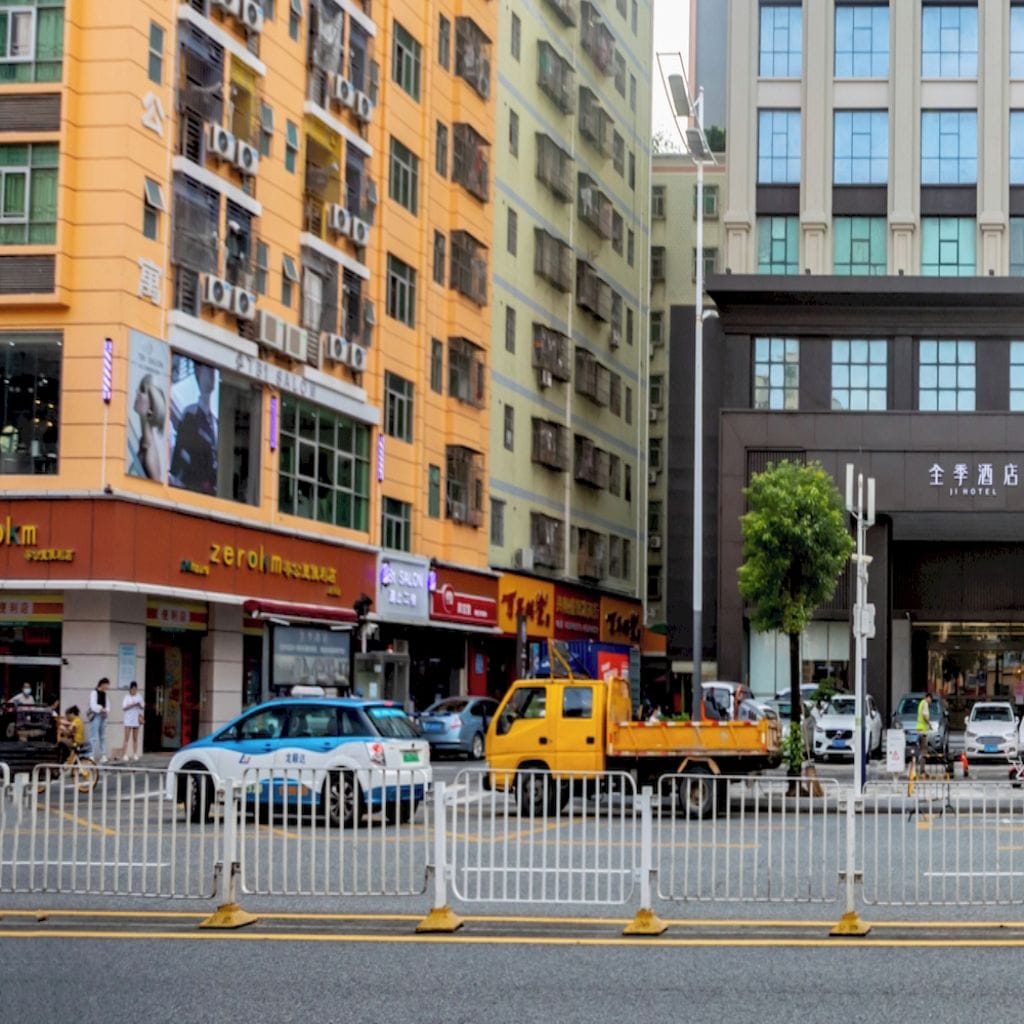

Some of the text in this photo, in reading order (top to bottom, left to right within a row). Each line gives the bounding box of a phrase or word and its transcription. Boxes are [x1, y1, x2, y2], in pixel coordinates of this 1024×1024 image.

[928, 463, 1019, 487] 全季酒店
[949, 487, 998, 497] JI HOTEL
[400, 570, 424, 588] SALON
